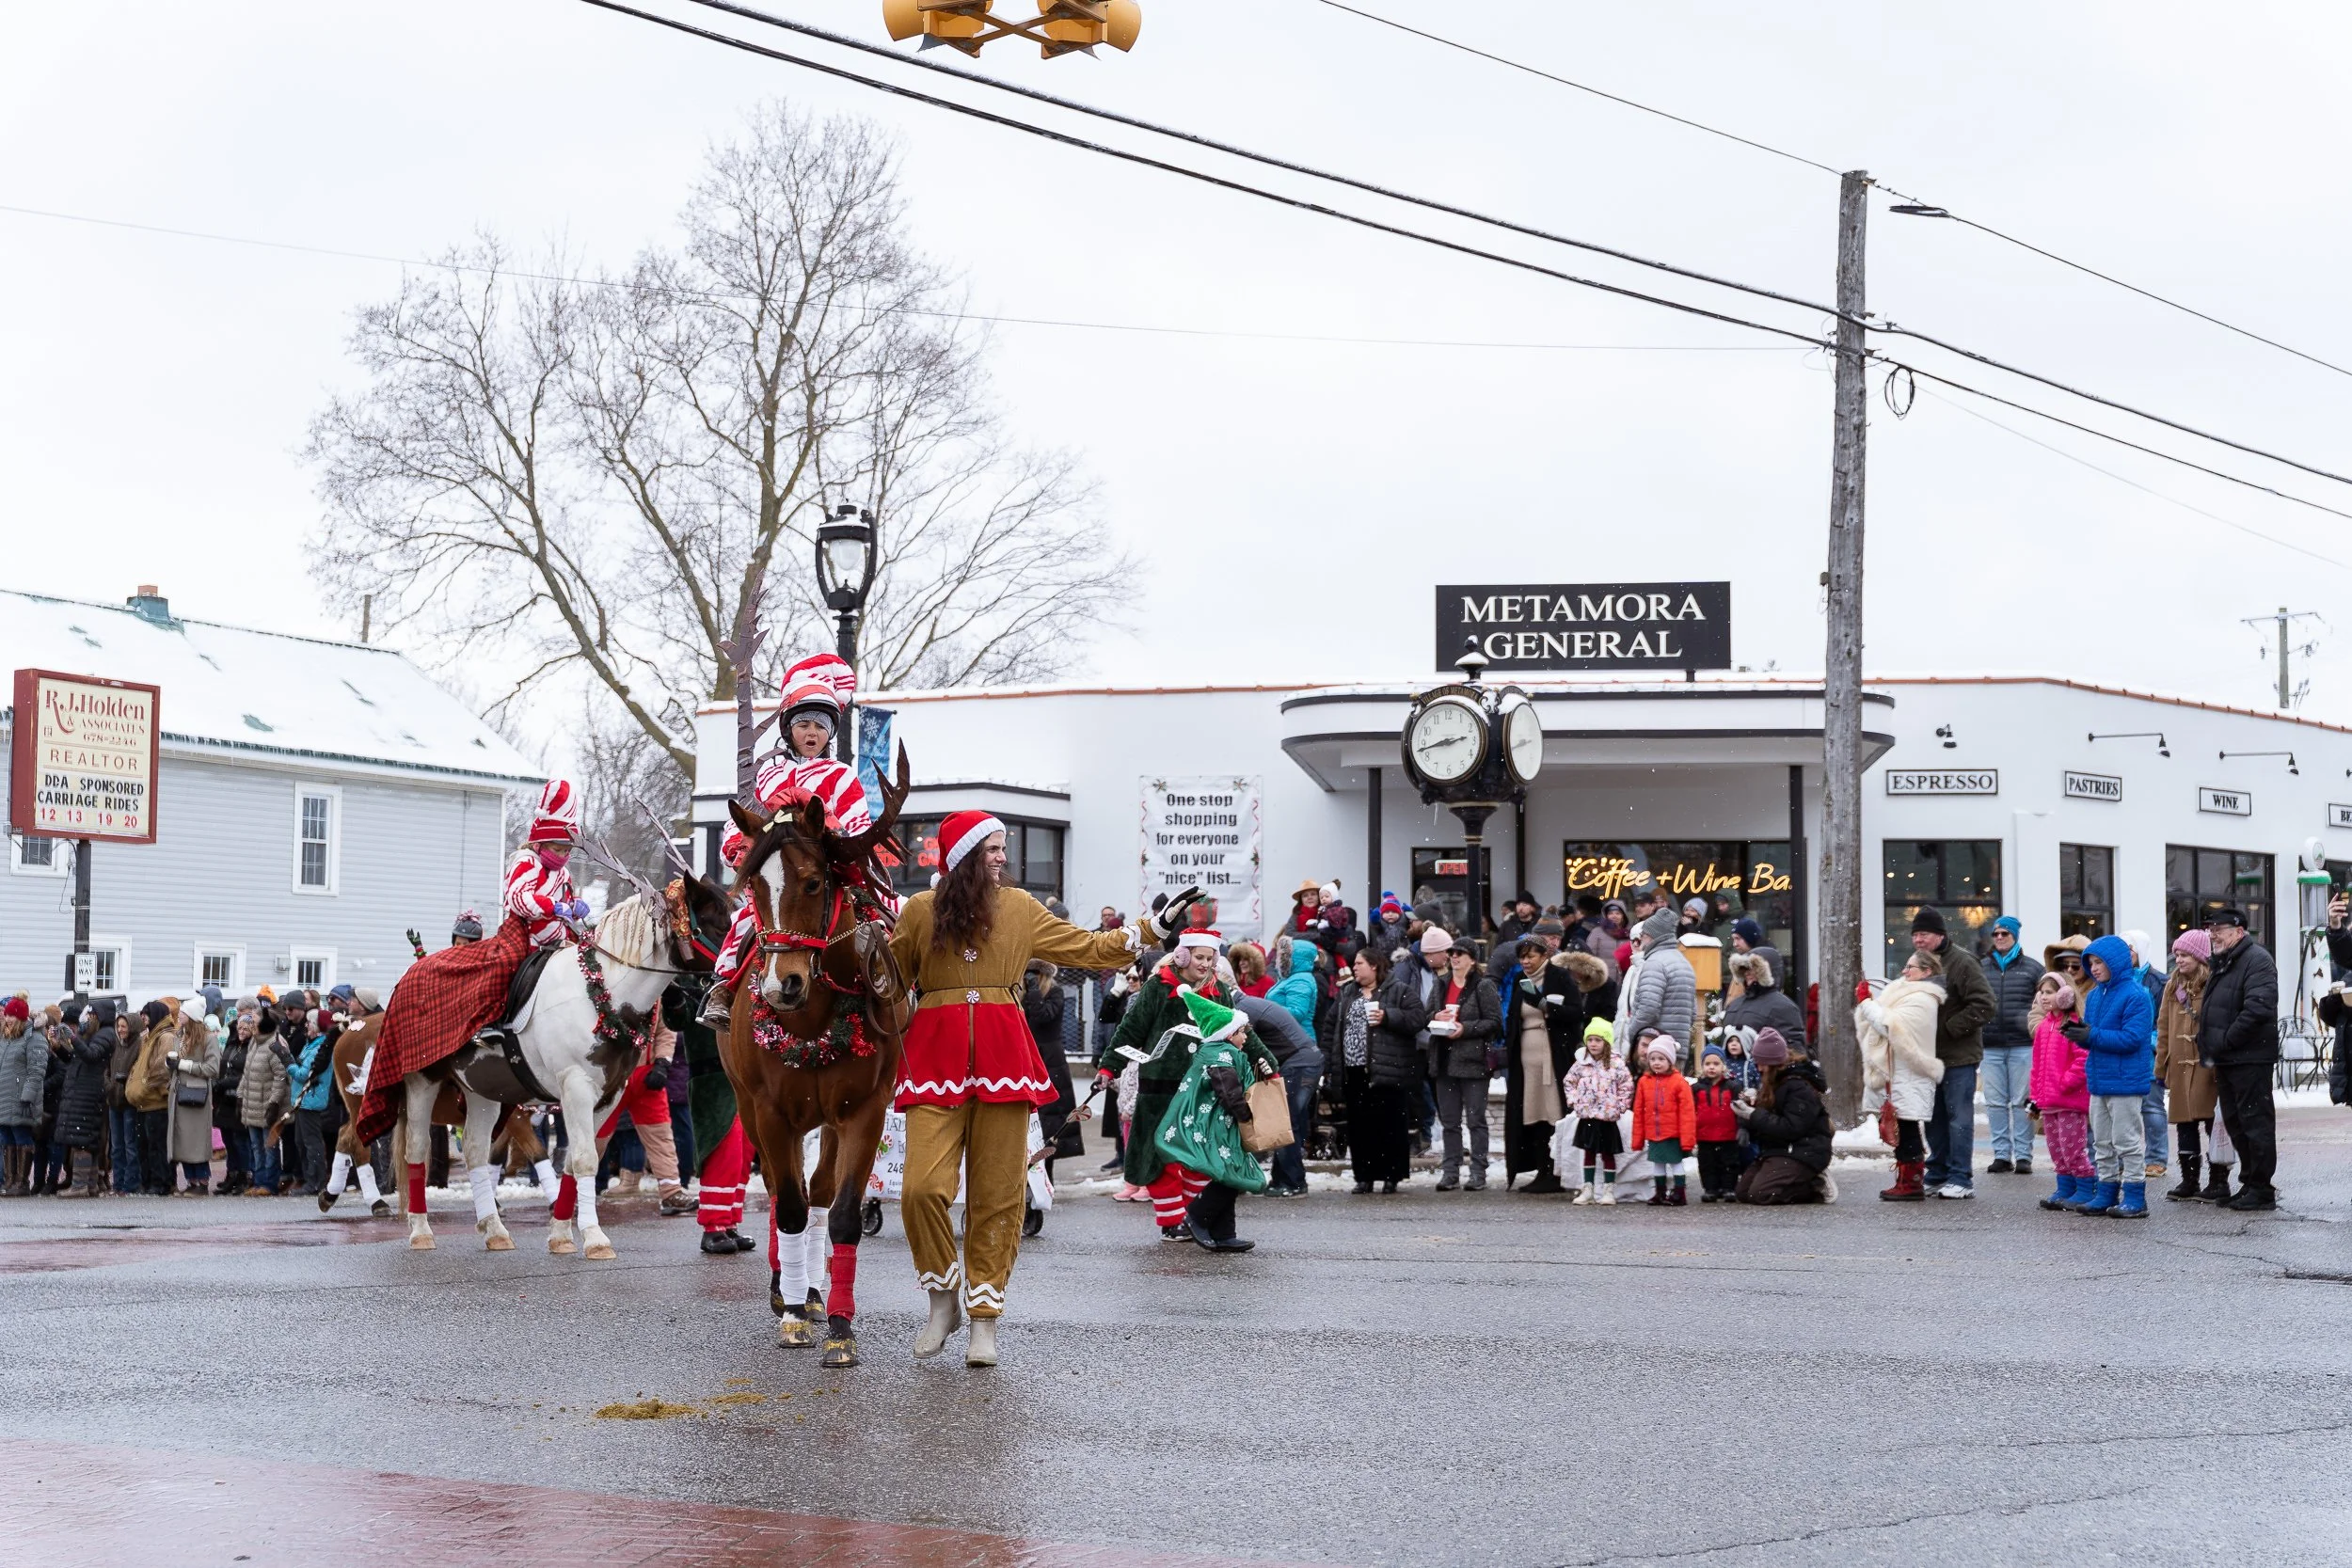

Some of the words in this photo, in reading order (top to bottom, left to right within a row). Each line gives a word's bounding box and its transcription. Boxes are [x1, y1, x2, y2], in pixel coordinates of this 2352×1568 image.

[1461, 593, 1707, 623] METAMORA
[1484, 630, 1683, 659] GENERAL
[1434, 715, 1439, 724] 11
[1445, 710, 1453, 720] 12
[80, 718, 145, 734] ASSOCIATES
[1423, 726, 1431, 736] 10
[1468, 722, 1473, 733] 2
[50, 749, 137, 770] REALTOR
[1424, 752, 1430, 762] 8
[1468, 749, 1473, 759] 4
[1446, 765, 1452, 774] 6
[44, 774, 69, 789] DDA
[80, 778, 144, 796] SPONSORED
[1892, 774, 1994, 790] ESPRESSO
[2069, 777, 2119, 797] PASTRIES
[38, 791, 98, 809] CARRIAGE
[104, 797, 139, 812] RIDES
[1167, 793, 1195, 806] One
[1200, 794, 1232, 807] stop
[2213, 794, 2239, 810] WINE
[40, 808, 56, 821] 12
[67, 810, 82, 823] 13
[98, 813, 113, 826] 19
[124, 815, 137, 828] 20
[1165, 813, 1237, 827] shopping
[1156, 832, 1174, 845] for
[1178, 834, 1239, 846] everyone
[1170, 853, 1188, 865] on
[1193, 853, 1225, 866] your
[1438, 863, 1468, 875] OPEN
[1159, 871, 1203, 884] "nice"
[1206, 872, 1241, 884] list...
[1567, 858, 1651, 898] Coffee
[1748, 863, 1793, 894] Ba
[78, 958, 93, 967] ONE
[887, 1163, 903, 1173] 248
